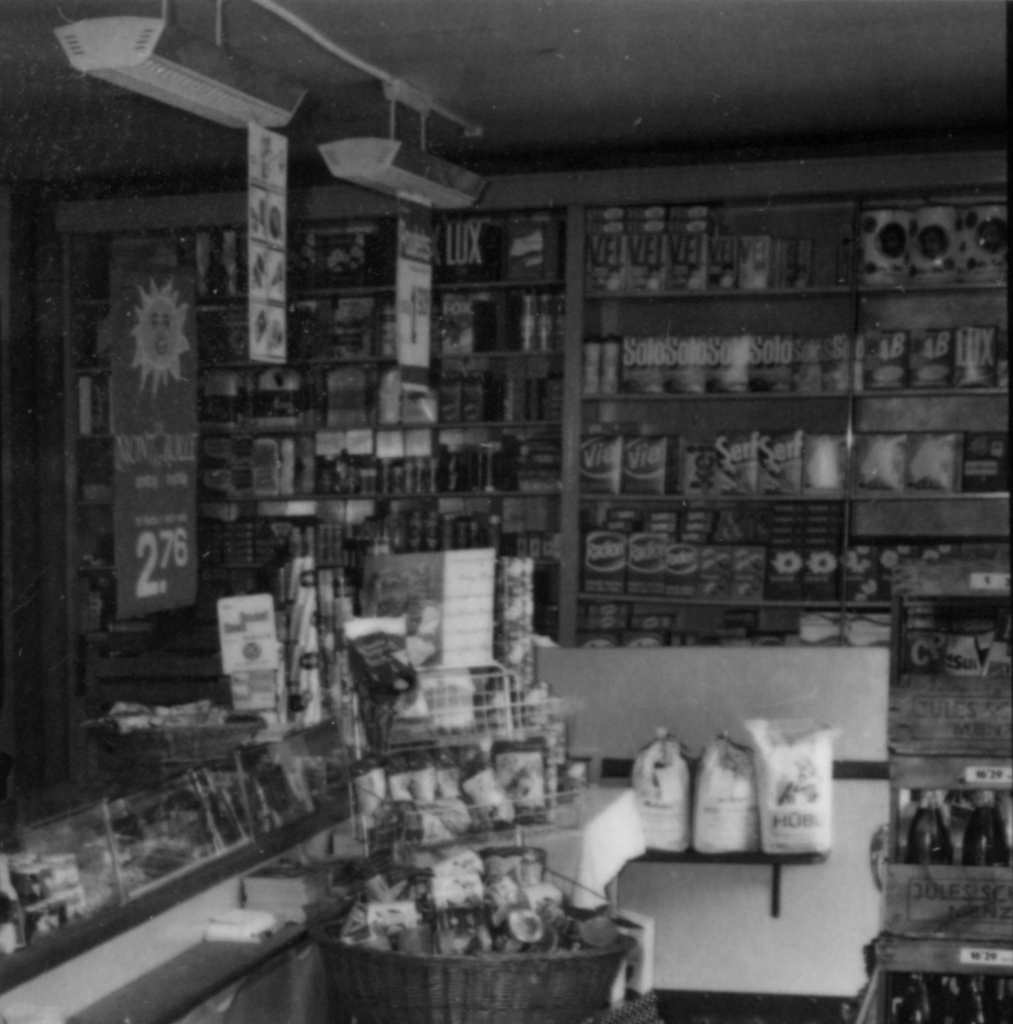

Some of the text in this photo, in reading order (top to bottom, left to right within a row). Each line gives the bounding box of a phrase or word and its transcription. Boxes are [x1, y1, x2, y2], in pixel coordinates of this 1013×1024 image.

[446, 220, 483, 266] LUX
[444, 302, 474, 316] FOX
[623, 338, 664, 366] Solo
[665, 337, 706, 366] Solo
[749, 336, 792, 364] Solo
[956, 327, 994, 367] LUX
[714, 431, 759, 475] Serf
[759, 430, 803, 474] Serf
[136, 527, 189, 598] 2.76
